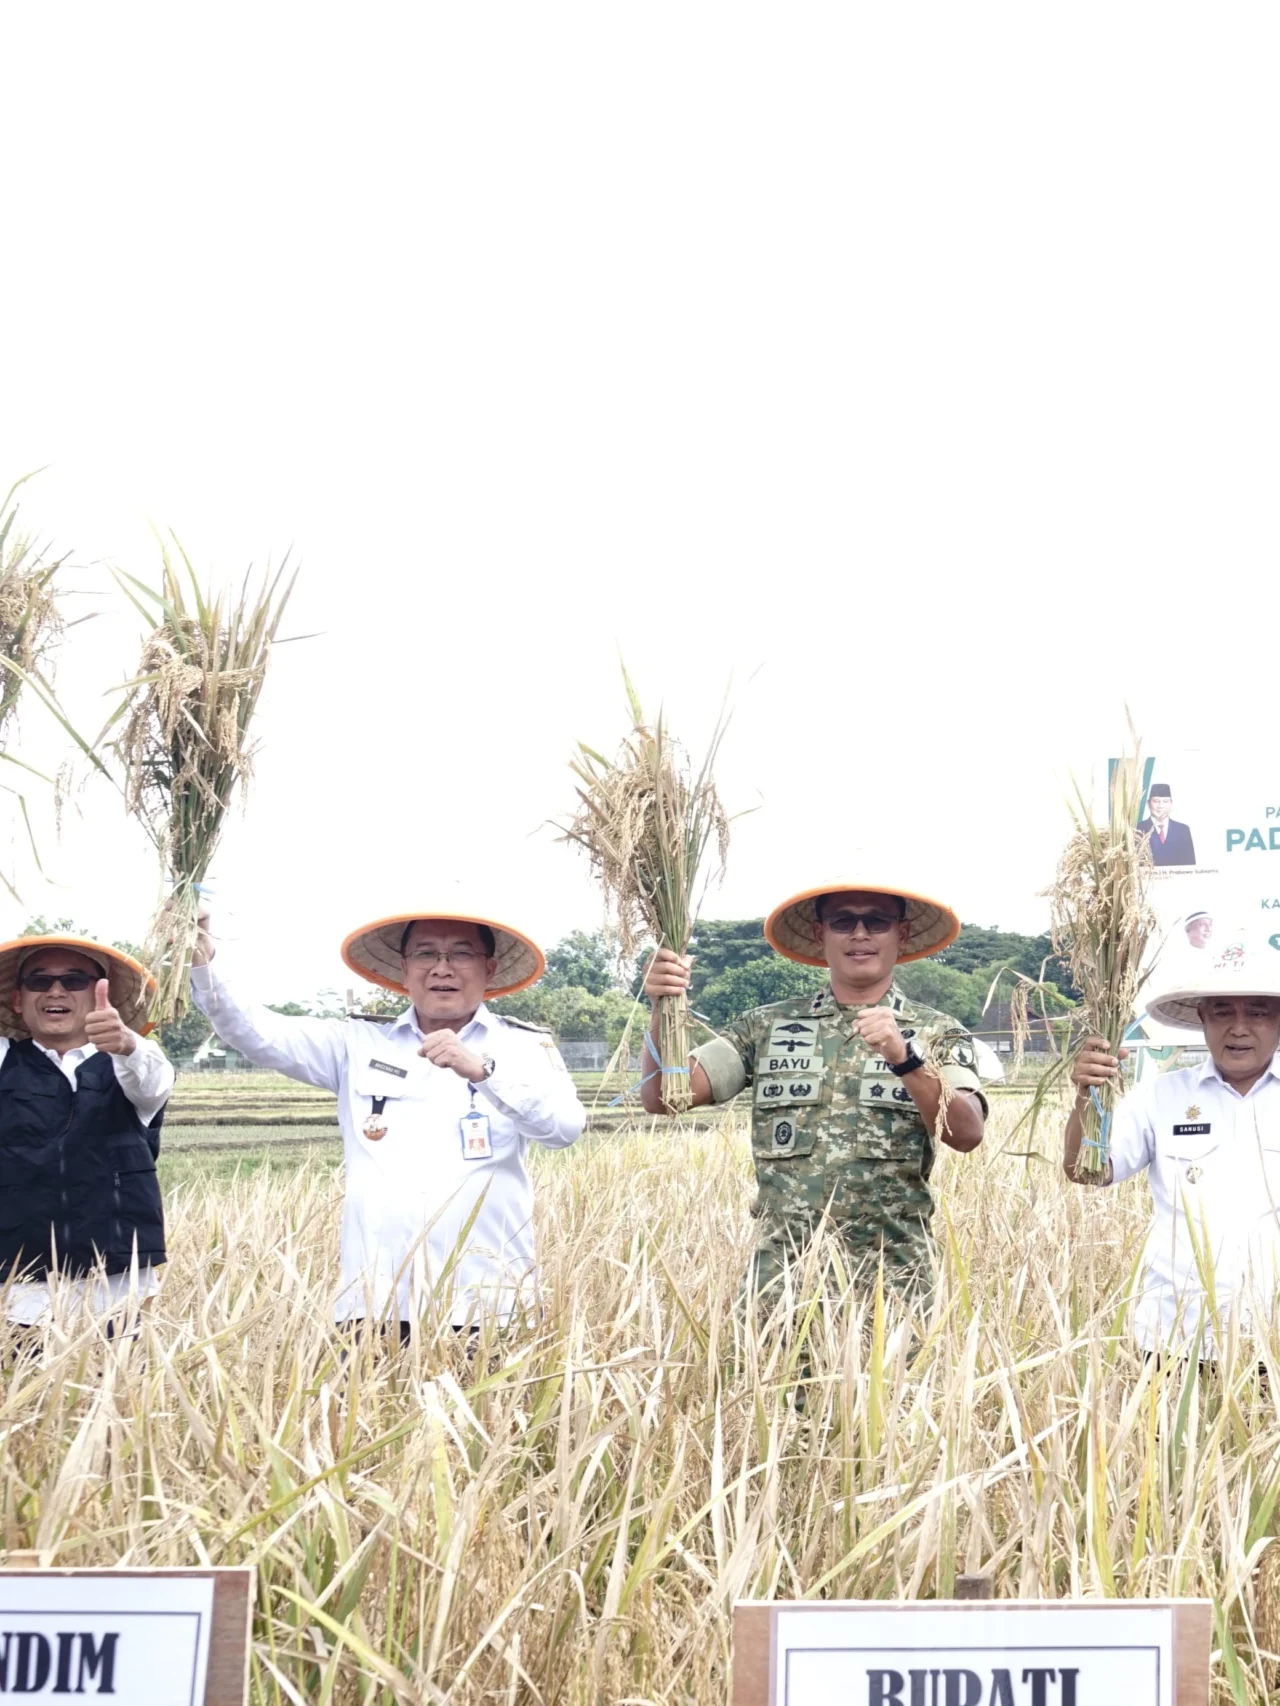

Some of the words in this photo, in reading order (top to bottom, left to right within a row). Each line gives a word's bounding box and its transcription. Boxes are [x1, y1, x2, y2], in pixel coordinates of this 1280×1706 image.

[769, 1058, 810, 1070] BAYU
[1179, 1125, 1204, 1133] SANUSI
[866, 1667, 1080, 1706] BUPATI
